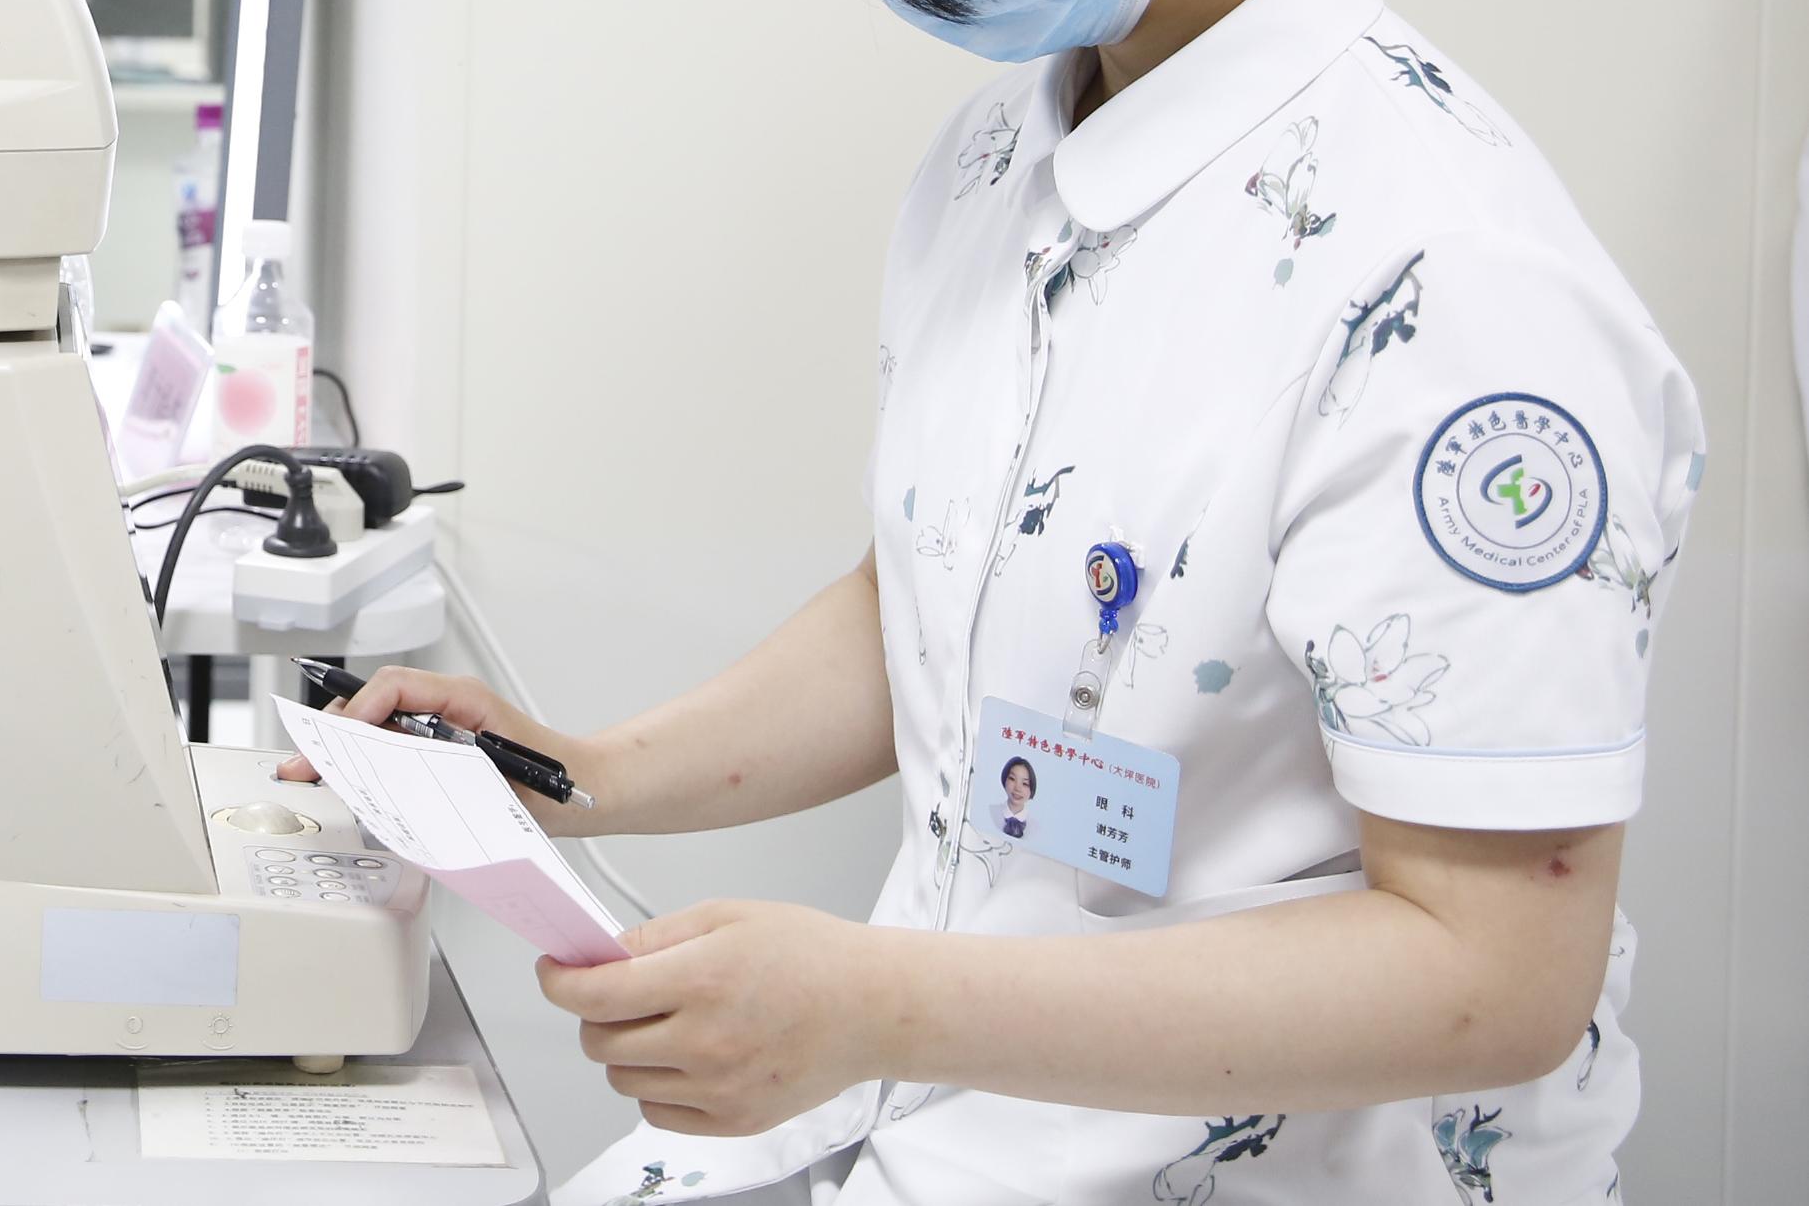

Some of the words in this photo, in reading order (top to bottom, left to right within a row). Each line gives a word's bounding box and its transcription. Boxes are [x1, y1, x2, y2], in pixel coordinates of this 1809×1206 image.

[1438, 496, 1462, 537] Army
[1577, 488, 1589, 519] PLA
[1571, 519, 1585, 537] of
[1461, 535, 1523, 567] Medical
[1525, 536, 1572, 567] Center
[1087, 846, 1133, 871] 主管护师
